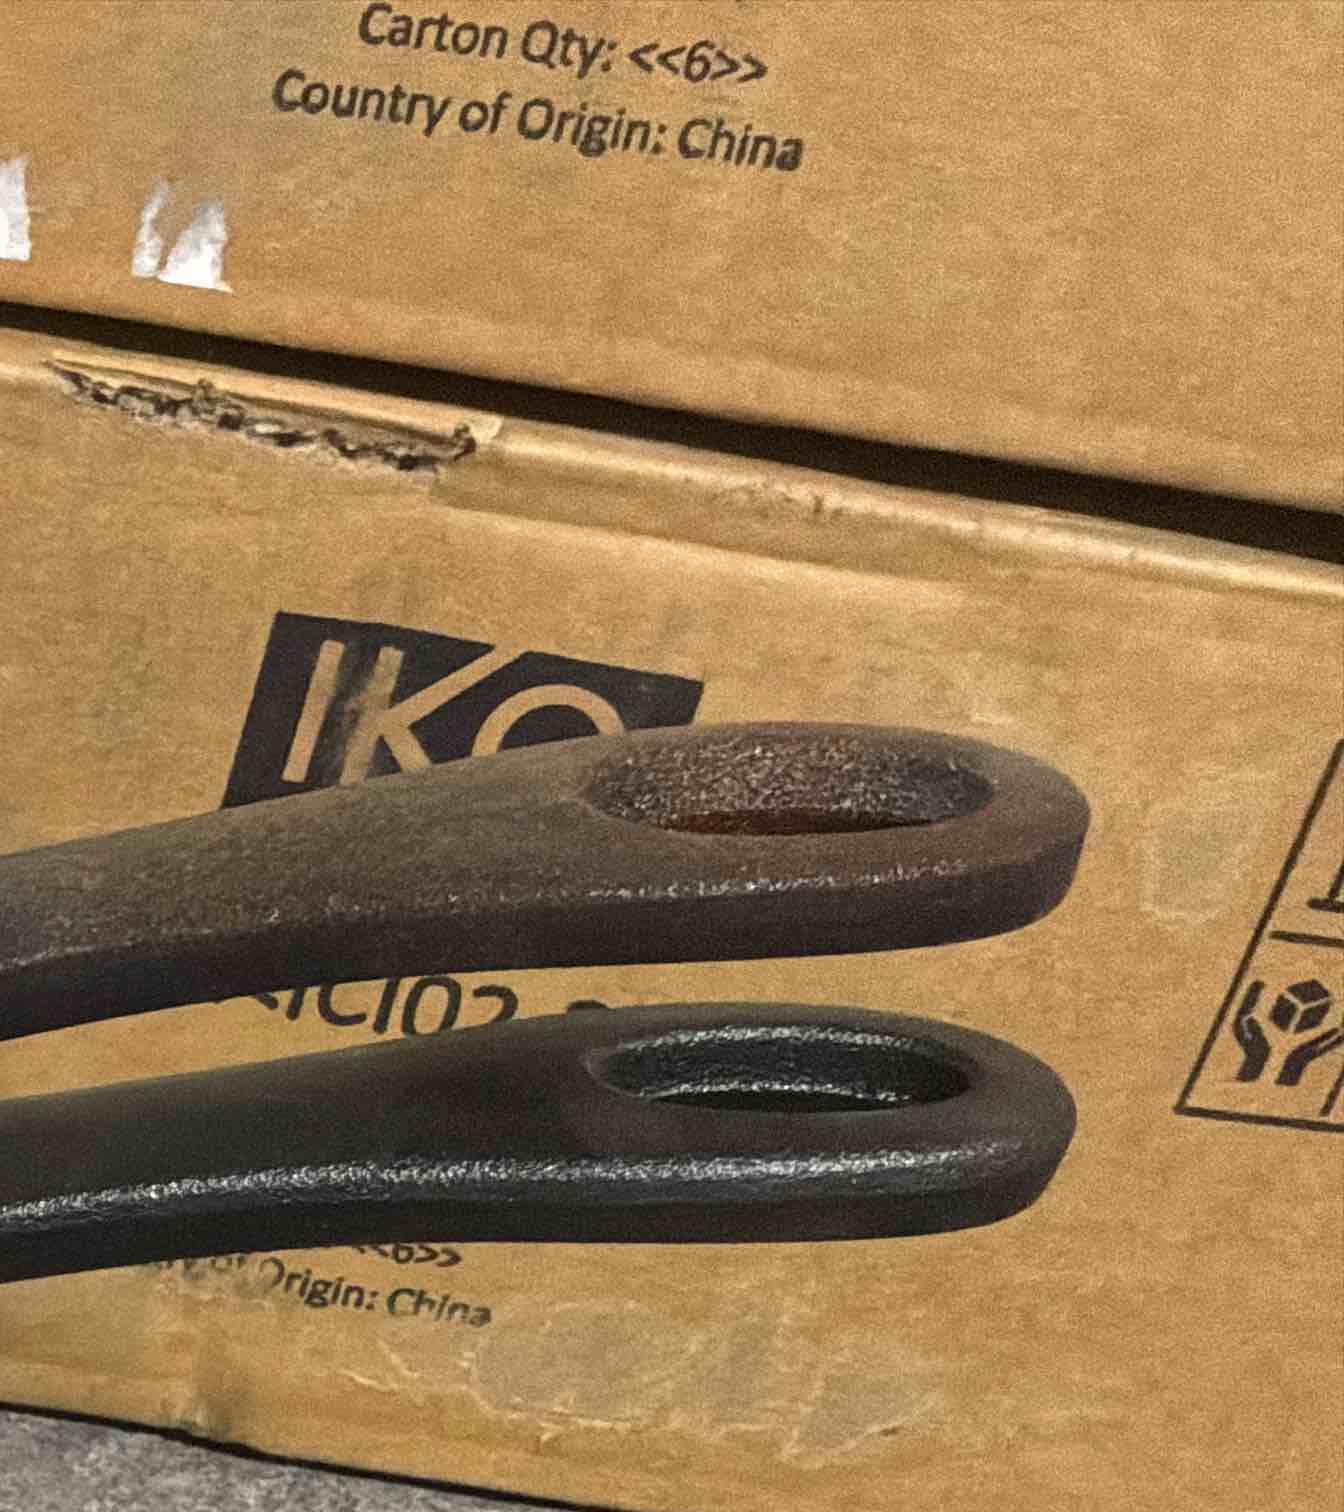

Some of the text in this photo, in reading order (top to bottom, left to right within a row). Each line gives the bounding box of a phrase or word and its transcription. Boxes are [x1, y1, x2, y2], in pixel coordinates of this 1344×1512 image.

[358, 2, 768, 84] Carton Qty: <<6>>
[272, 69, 805, 172] Country of Origin: China
